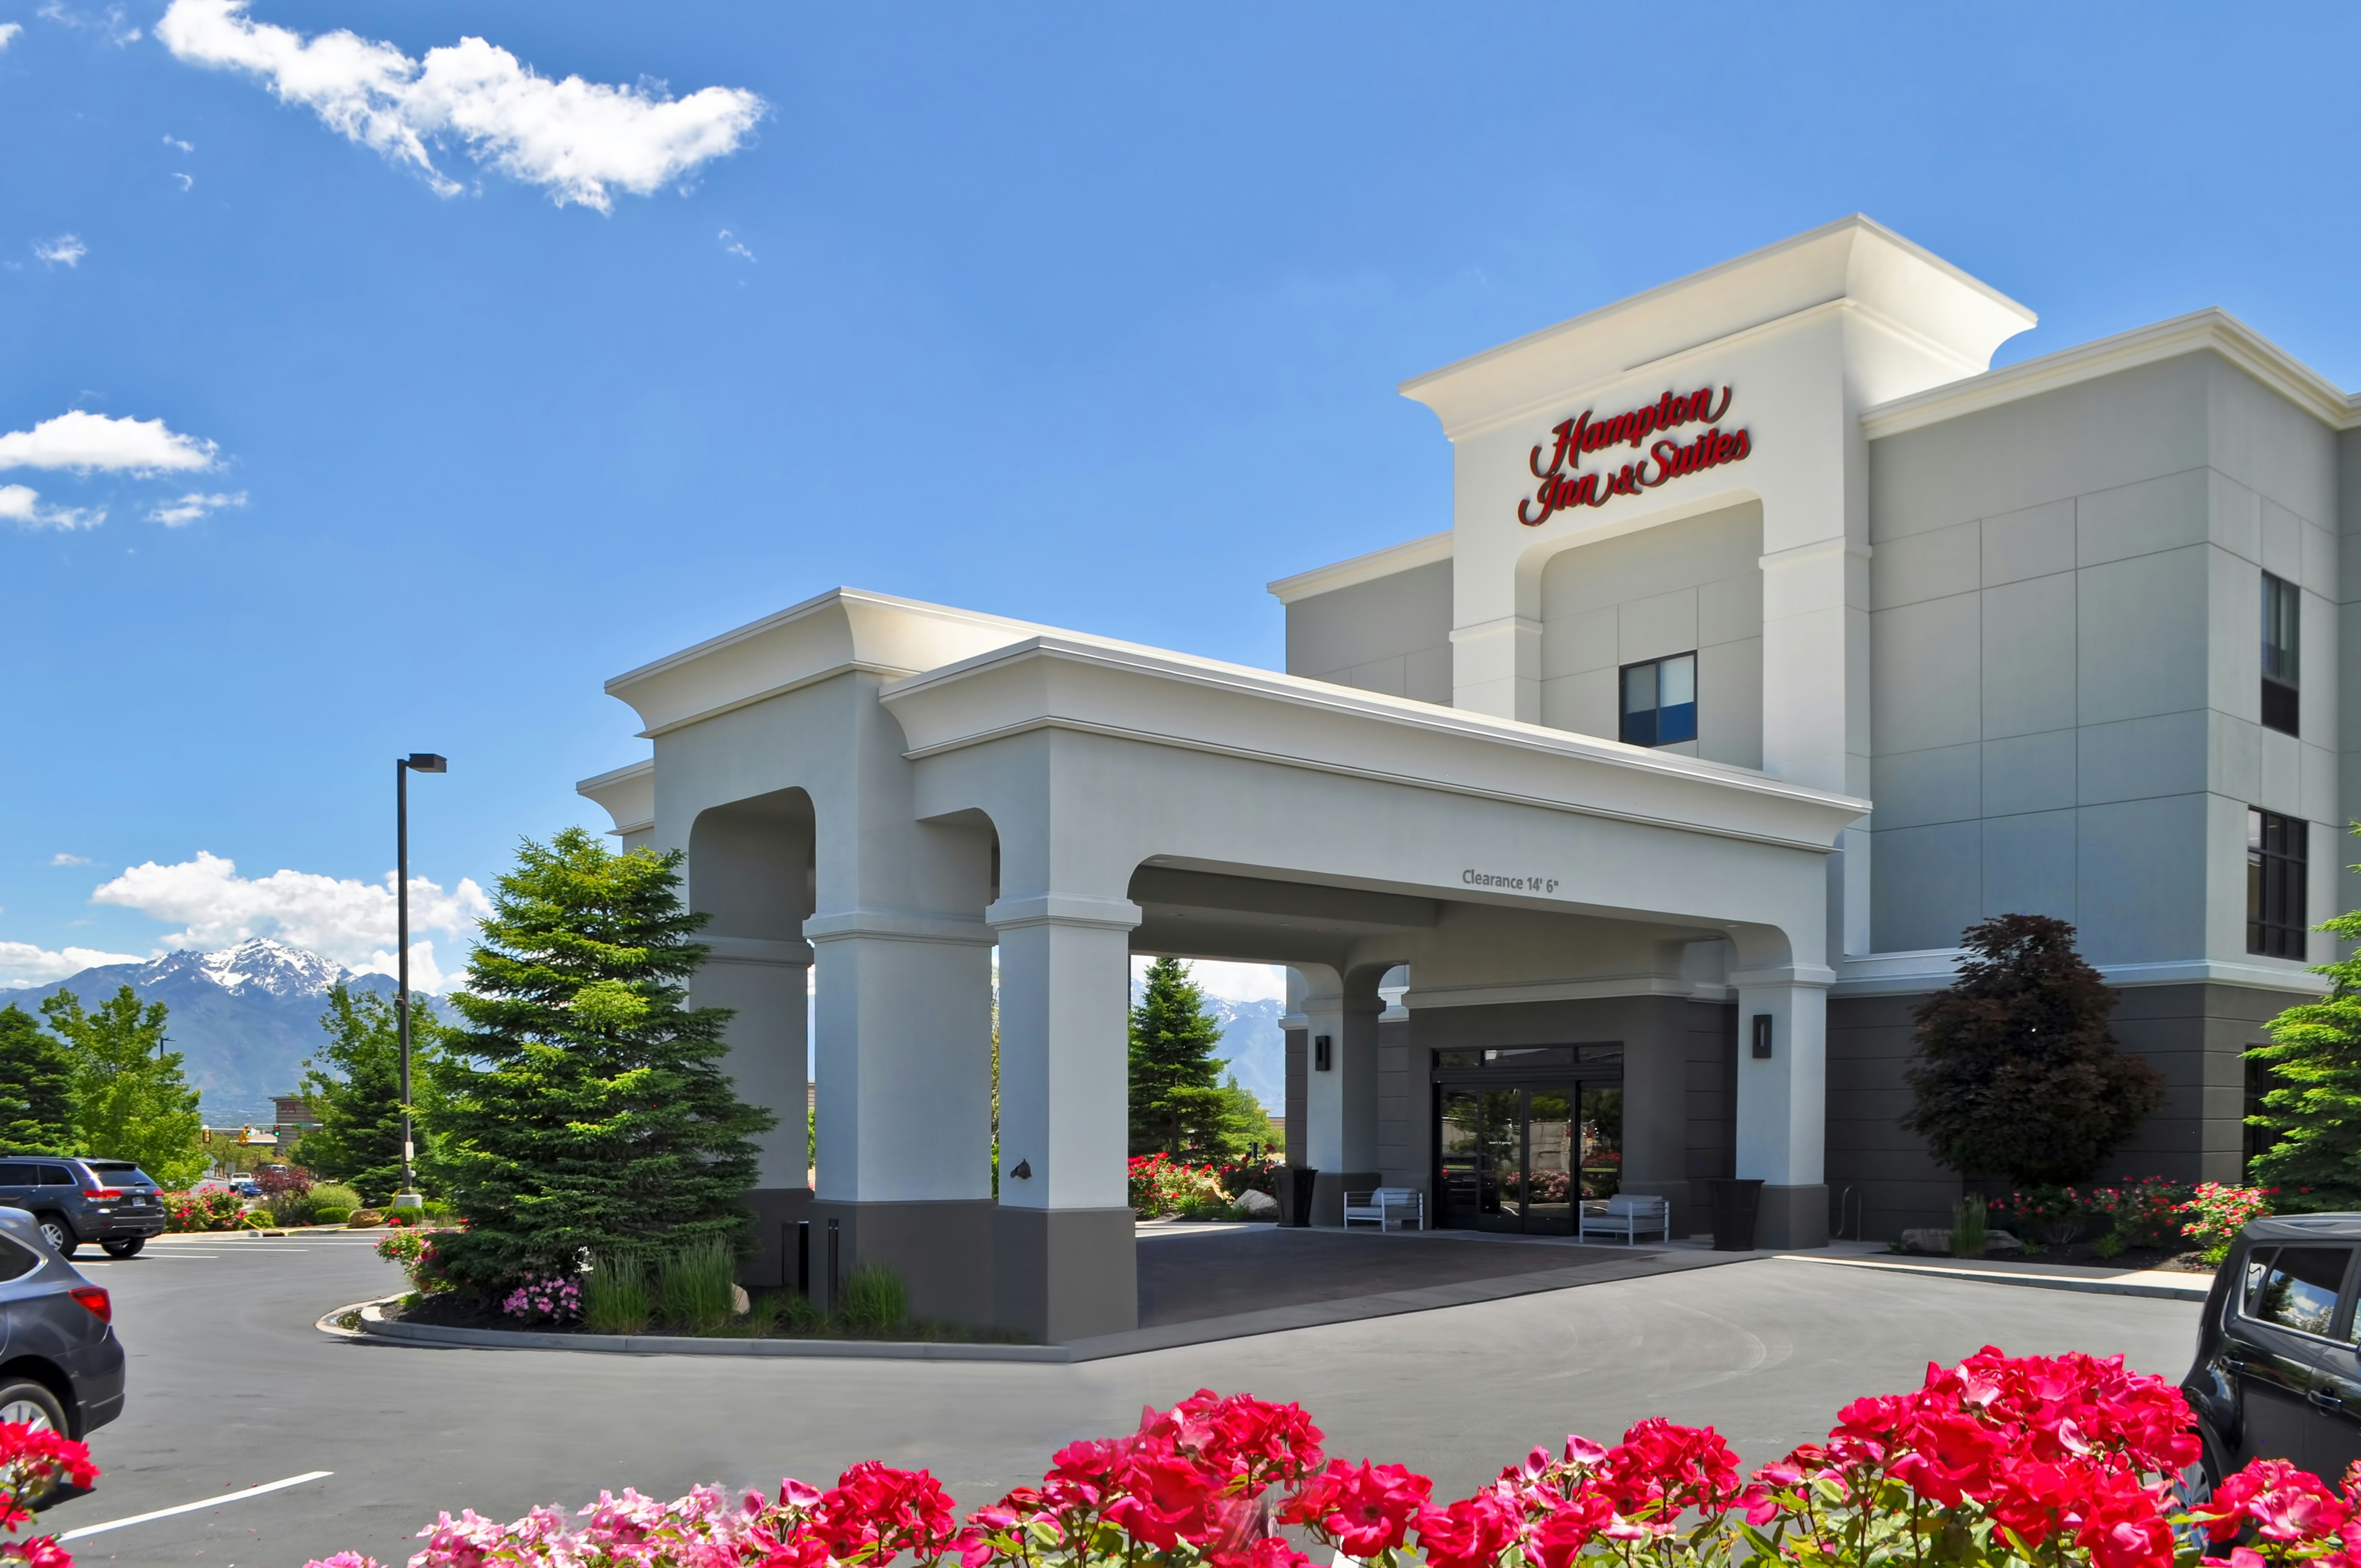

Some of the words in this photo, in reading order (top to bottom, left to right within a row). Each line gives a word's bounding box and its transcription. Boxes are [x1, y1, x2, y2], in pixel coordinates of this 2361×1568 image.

[1518, 472, 1613, 526] Inn
[1612, 464, 1642, 495] &
[1635, 428, 1751, 488] Suites
[1530, 385, 1731, 478] Hampton
[1462, 868, 1524, 889] Clearance
[1526, 877, 1543, 892] 14'
[1546, 879, 1559, 894] 6"
